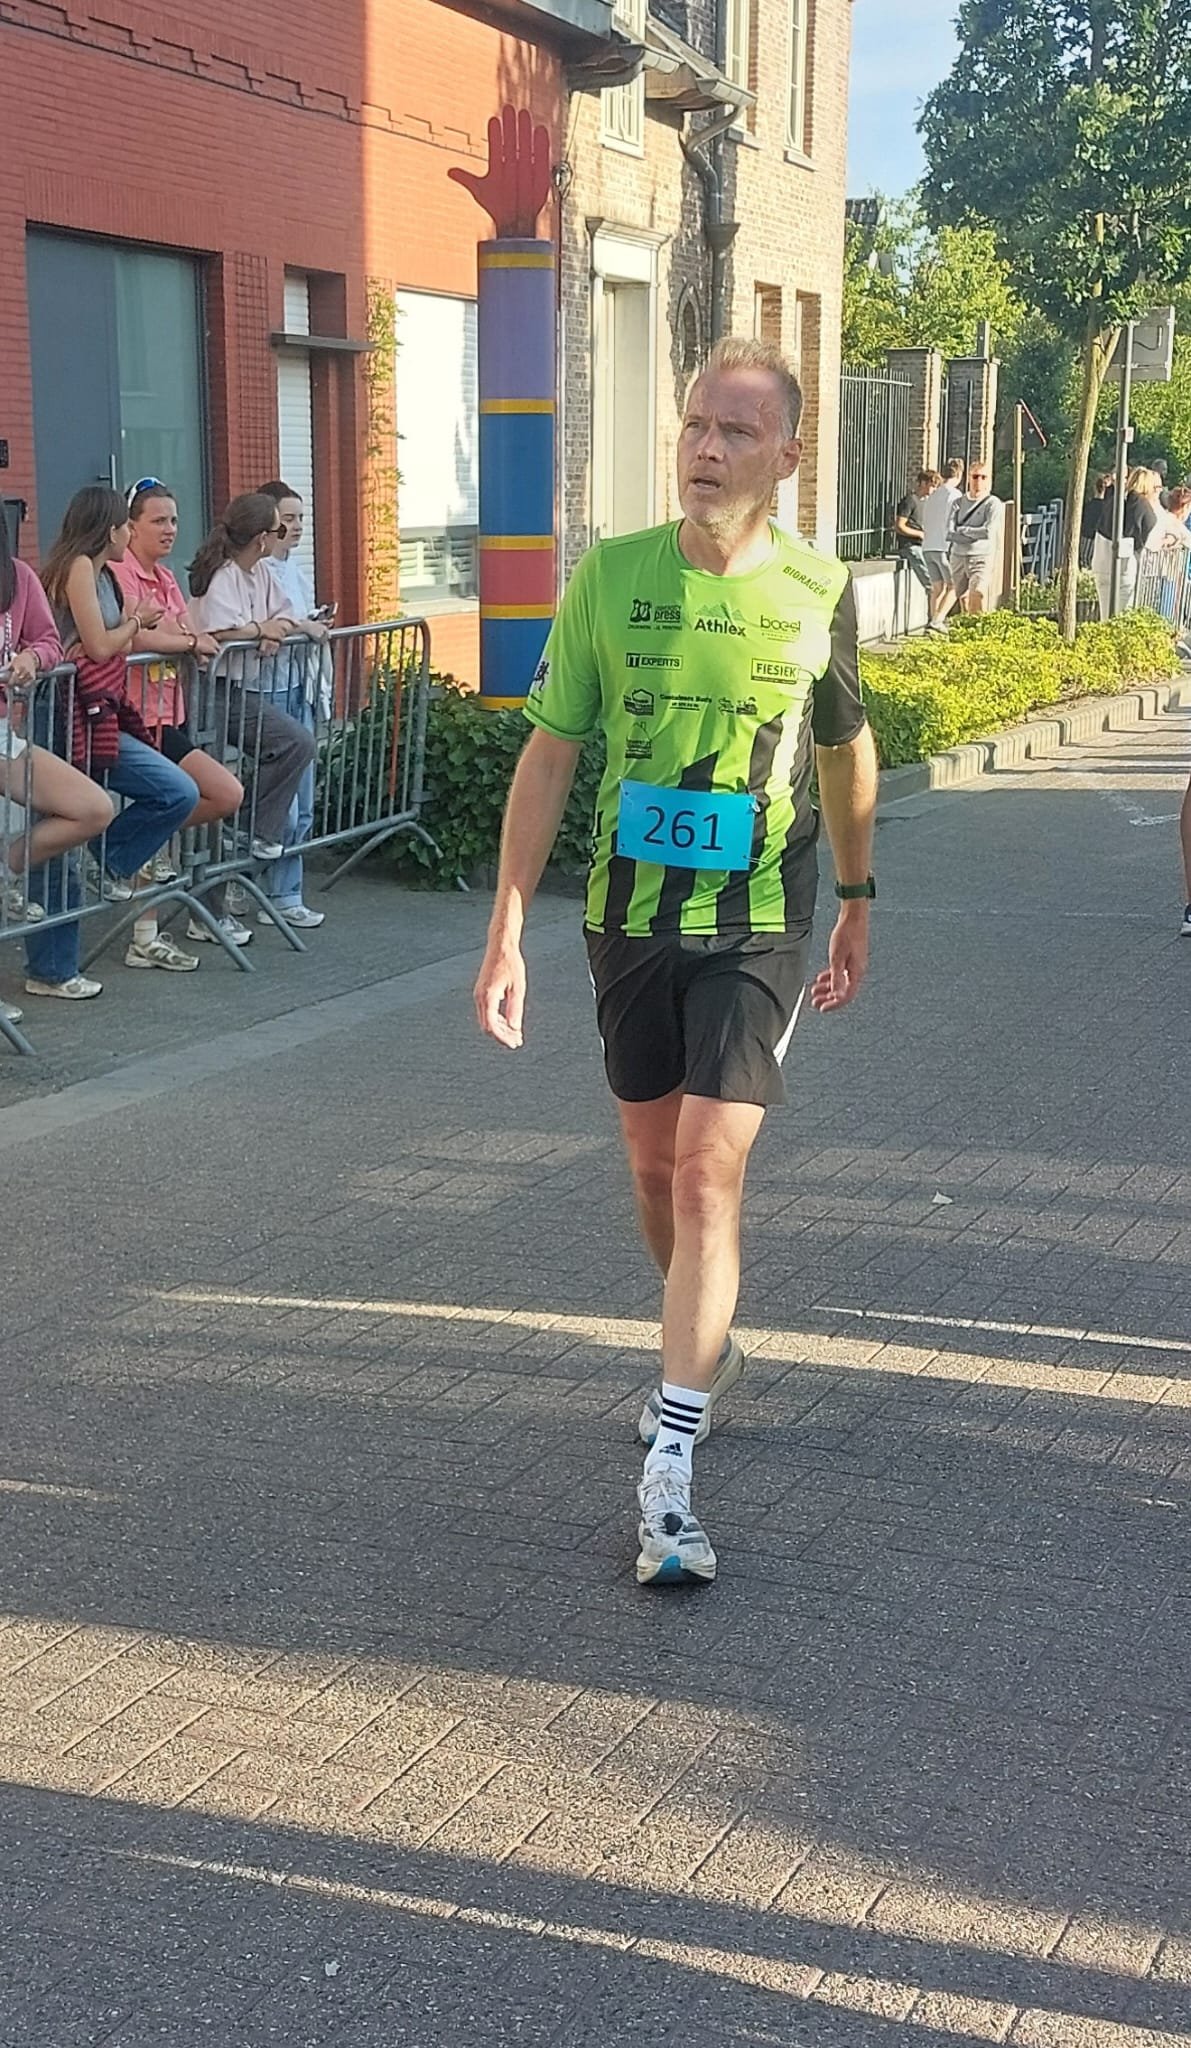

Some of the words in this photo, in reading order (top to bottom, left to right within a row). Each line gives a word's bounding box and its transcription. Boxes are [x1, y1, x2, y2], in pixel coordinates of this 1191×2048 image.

[783, 566, 828, 597] BIORACER
[653, 610, 681, 621] press
[694, 618, 746, 637] Athlex
[641, 657, 680, 667] EXPERTS
[756, 663, 797, 678] FIESIEK
[643, 806, 723, 851] 261
